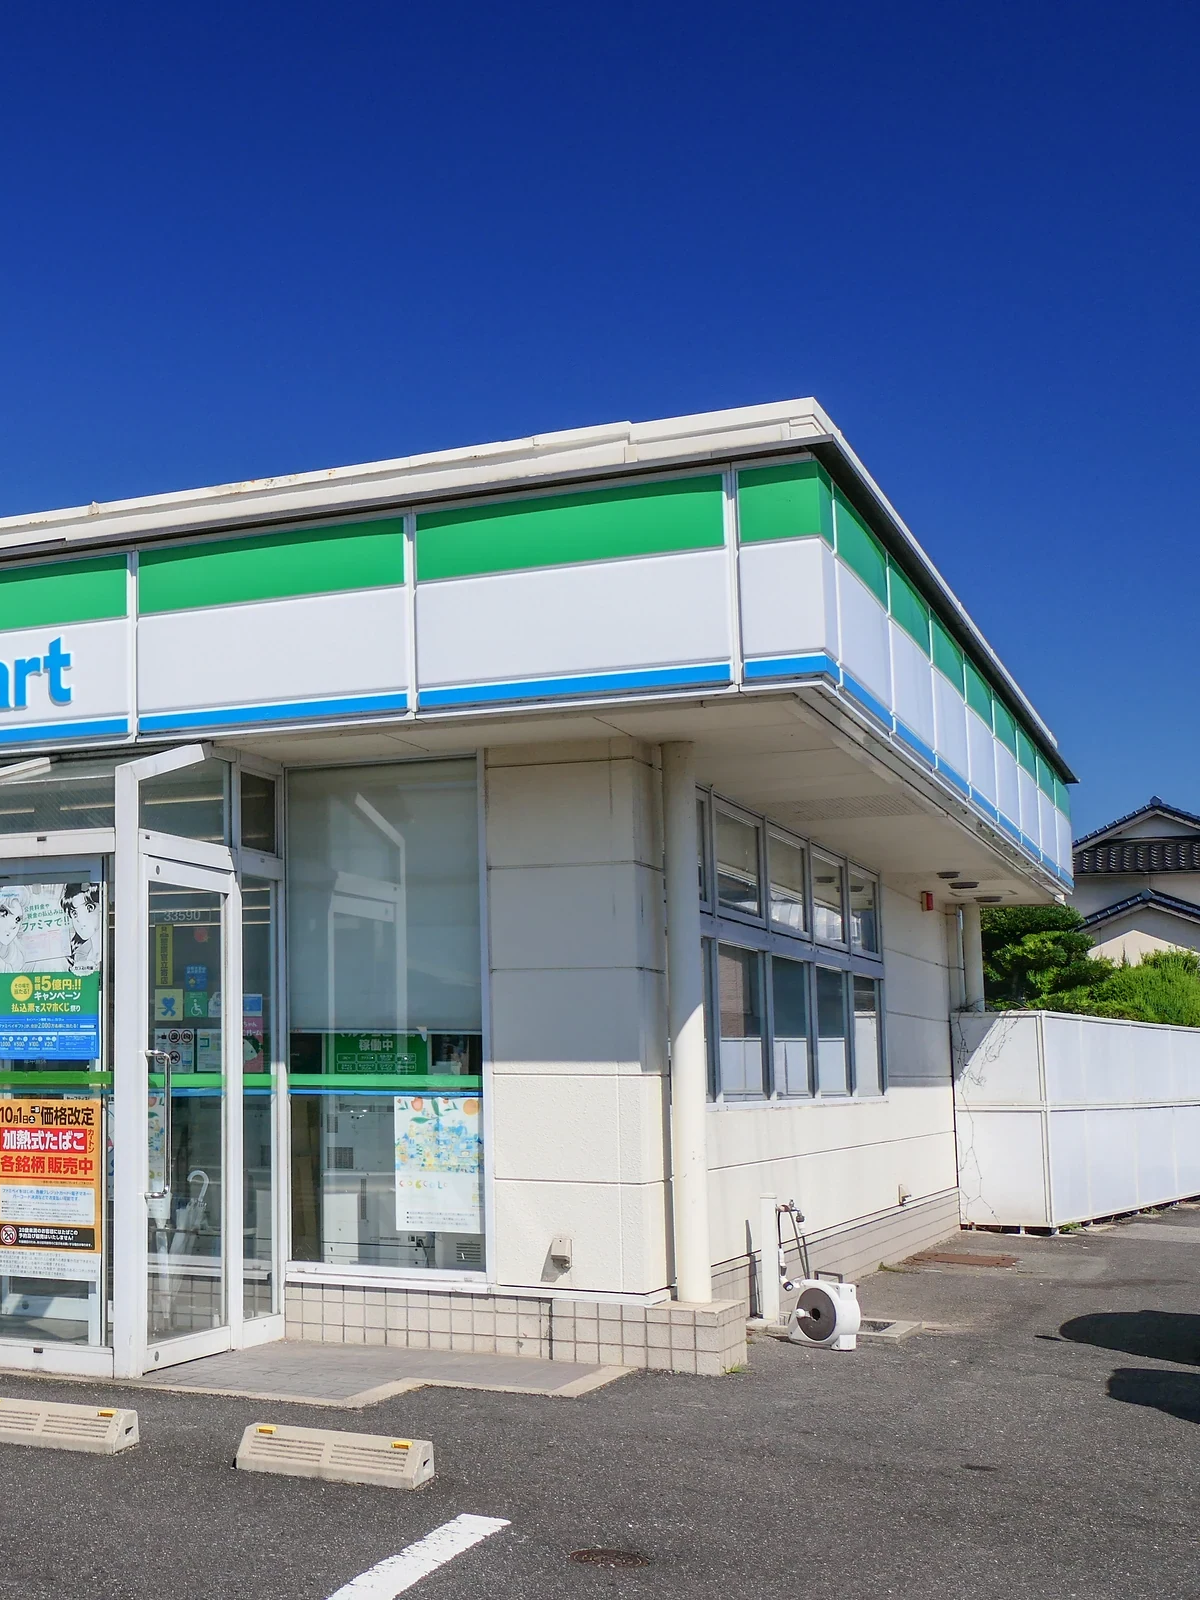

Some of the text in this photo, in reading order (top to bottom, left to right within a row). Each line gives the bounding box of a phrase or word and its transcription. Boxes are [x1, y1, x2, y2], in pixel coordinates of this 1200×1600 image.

[22, 916, 70, 932] ファミマで!!
[164, 910, 201, 922] 33590
[34, 991, 81, 1001] キャンペーン
[11, 1002, 81, 1012] 払込票でスマホくじ祭り
[359, 1038, 393, 1051] 稼働中
[40, 1106, 95, 1126] 価格改定
[2, 1129, 85, 1151] 加熱式たばこ
[87, 1128, 95, 1154] カートン
[0, 1155, 94, 1176] 各銘柄 販売中
